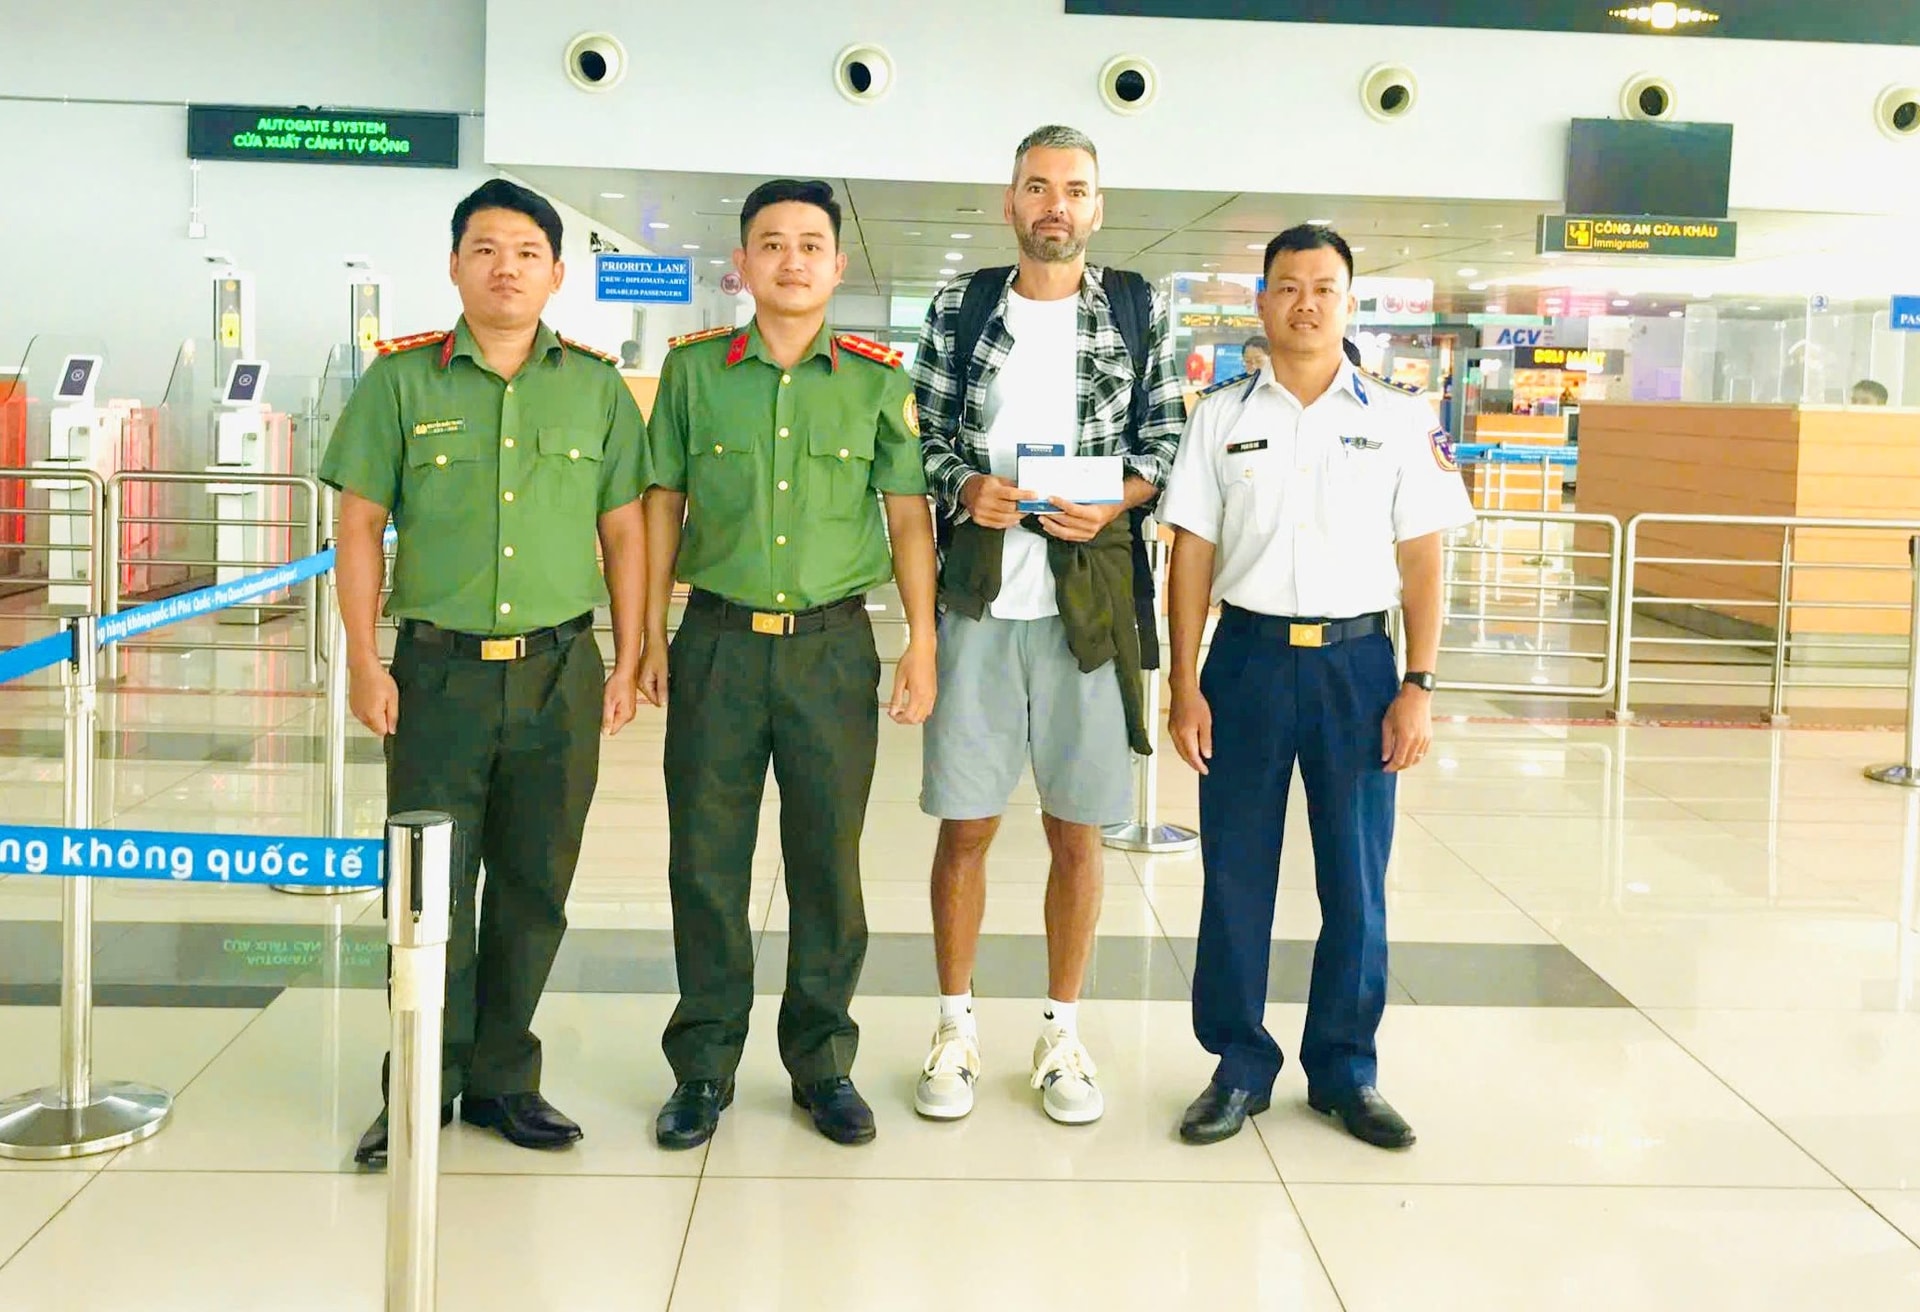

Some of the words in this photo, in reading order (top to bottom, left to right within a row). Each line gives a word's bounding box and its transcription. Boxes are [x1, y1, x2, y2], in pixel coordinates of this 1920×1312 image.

[258, 118, 329, 131] AUTOGATE
[333, 121, 386, 134] SYSTEM
[368, 138, 410, 155] ĐỘNG
[1595, 221, 1632, 234] CÔNG
[1633, 224, 1651, 235] AN
[1594, 238, 1649, 249] Immigration
[601, 261, 653, 271] PRIORITY
[658, 263, 687, 273] LANE
[626, 276, 665, 284] DIPLOMATS
[1496, 328, 1542, 345] ACV
[0, 838, 49, 873] ng
[62, 836, 193, 879] không
[207, 843, 309, 880] quốc
[324, 845, 365, 878] tế
